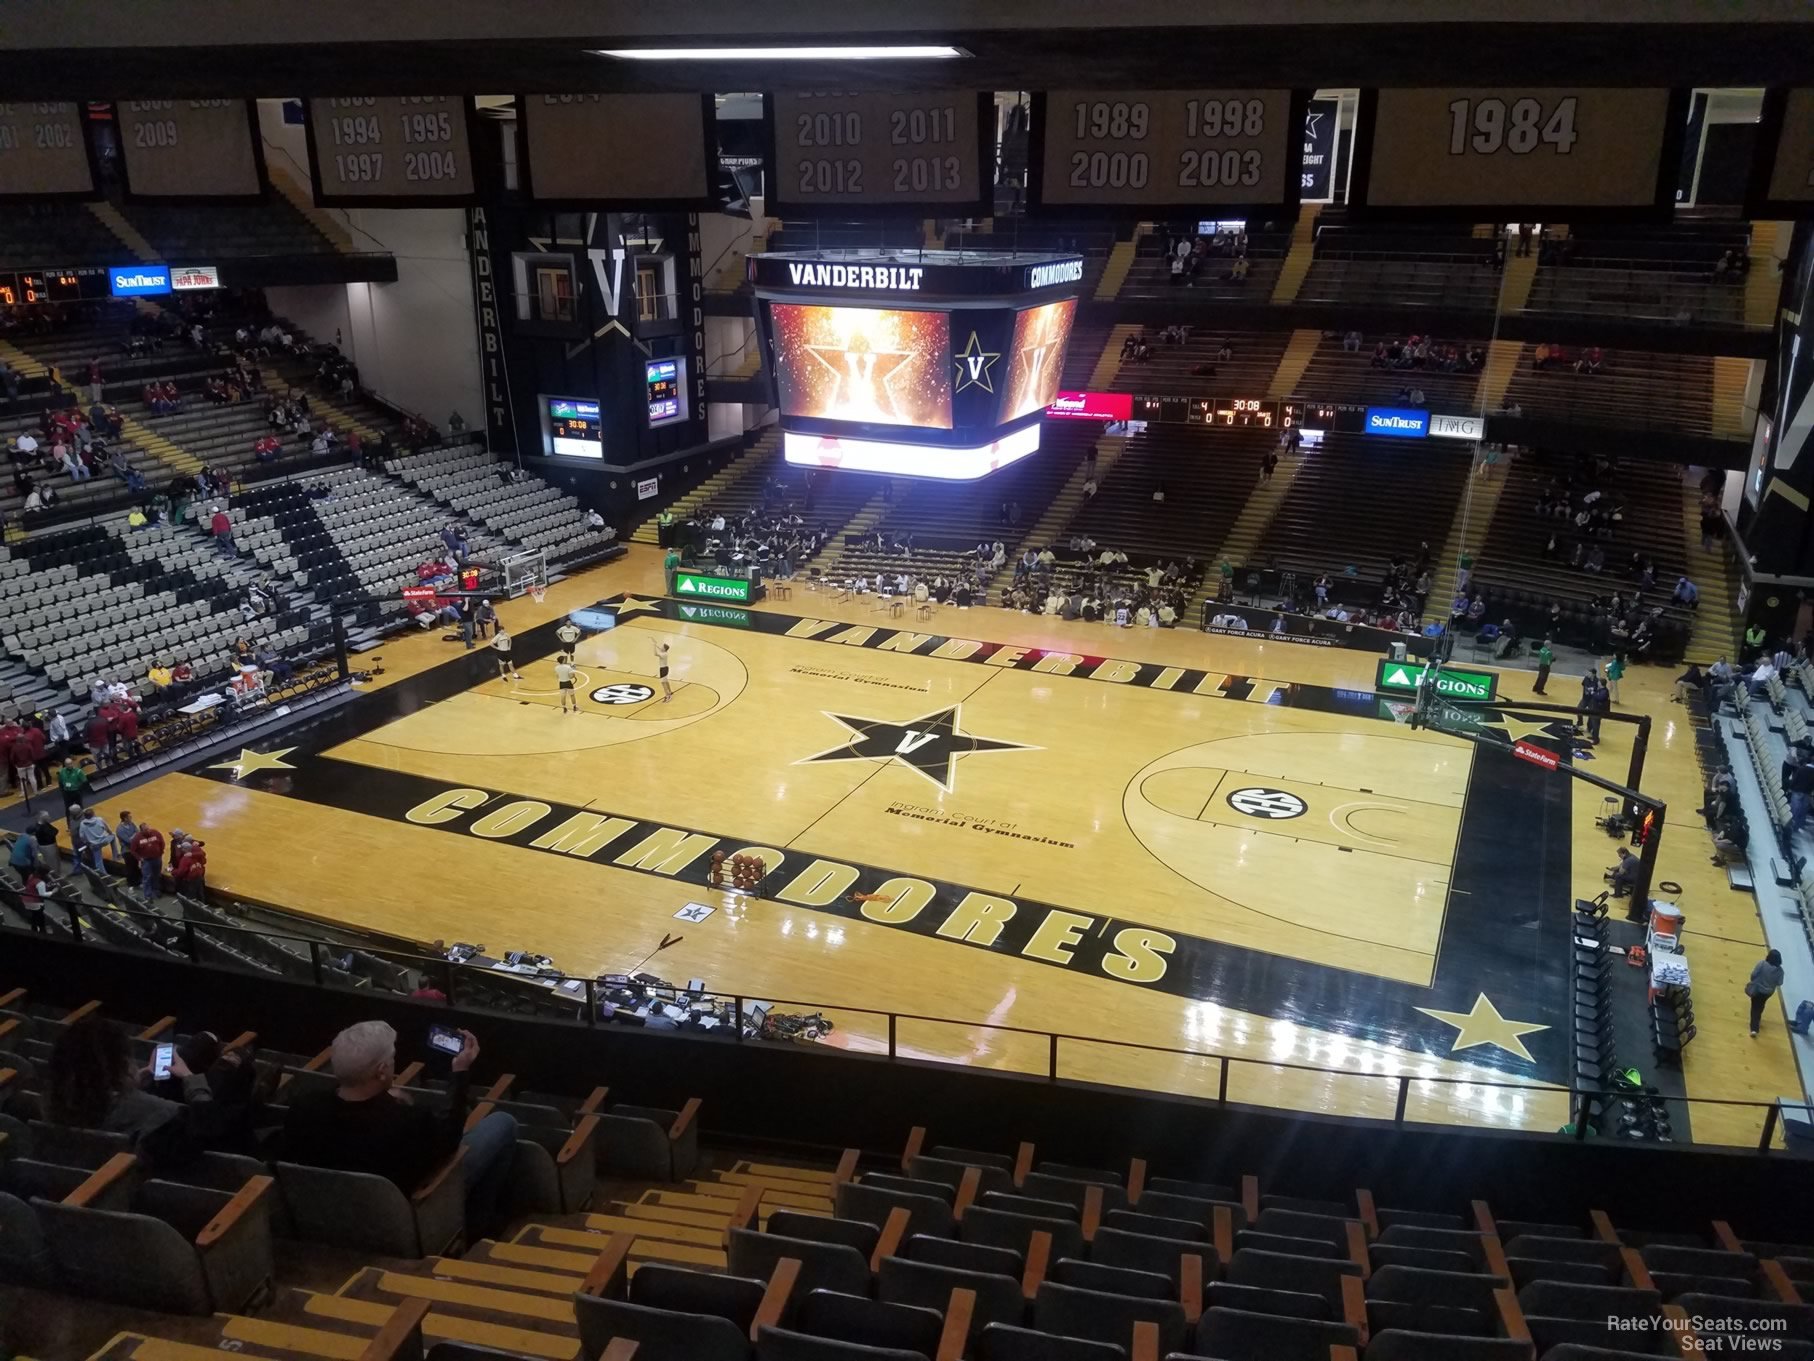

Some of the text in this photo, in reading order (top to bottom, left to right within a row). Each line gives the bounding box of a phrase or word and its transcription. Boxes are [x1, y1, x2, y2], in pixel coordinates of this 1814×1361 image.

[332, 113, 452, 145] 1994 1995
[797, 107, 956, 146] 2010 2011
[1074, 98, 1265, 140] 1989 1998
[1448, 97, 1579, 154] 1984
[34, 124, 73, 148] 2002
[134, 120, 177, 147] 2009
[336, 151, 457, 182] 1997 2004
[799, 156, 961, 193] 2012 2013
[1069, 149, 1262, 189] 2000 2003
[588, 249, 625, 316] V
[788, 263, 924, 290] VANDERBILT
[1030, 260, 1083, 289] COMMODORES
[27, 290, 36, 302] 0
[473, 207, 505, 426] ANDERBILT
[688, 213, 706, 420] OMMODORES
[967, 356, 984, 379] V
[1205, 413, 1212, 423] 0
[1233, 400, 1260, 411] 30:08
[568, 419, 588, 430] 30:08
[1226, 415, 1233, 425] 0
[1264, 417, 1271, 427] 0
[1284, 417, 1291, 427] 0
[640, 482, 656, 493] ESPN
[1227, 629, 1245, 637] FORCE
[1246, 631, 1265, 639] ACURA
[1275, 634, 1331, 646] GARY FORCE ACURA
[785, 617, 1293, 704] VANDERBILT
[1415, 674, 1486, 696] RGIONS
[894, 729, 940, 755] V
[884, 806, 1075, 849] Memorial Gymnasium
[890, 800, 1018, 830] Ingram Court at
[404, 788, 1178, 984] COMMODORES
